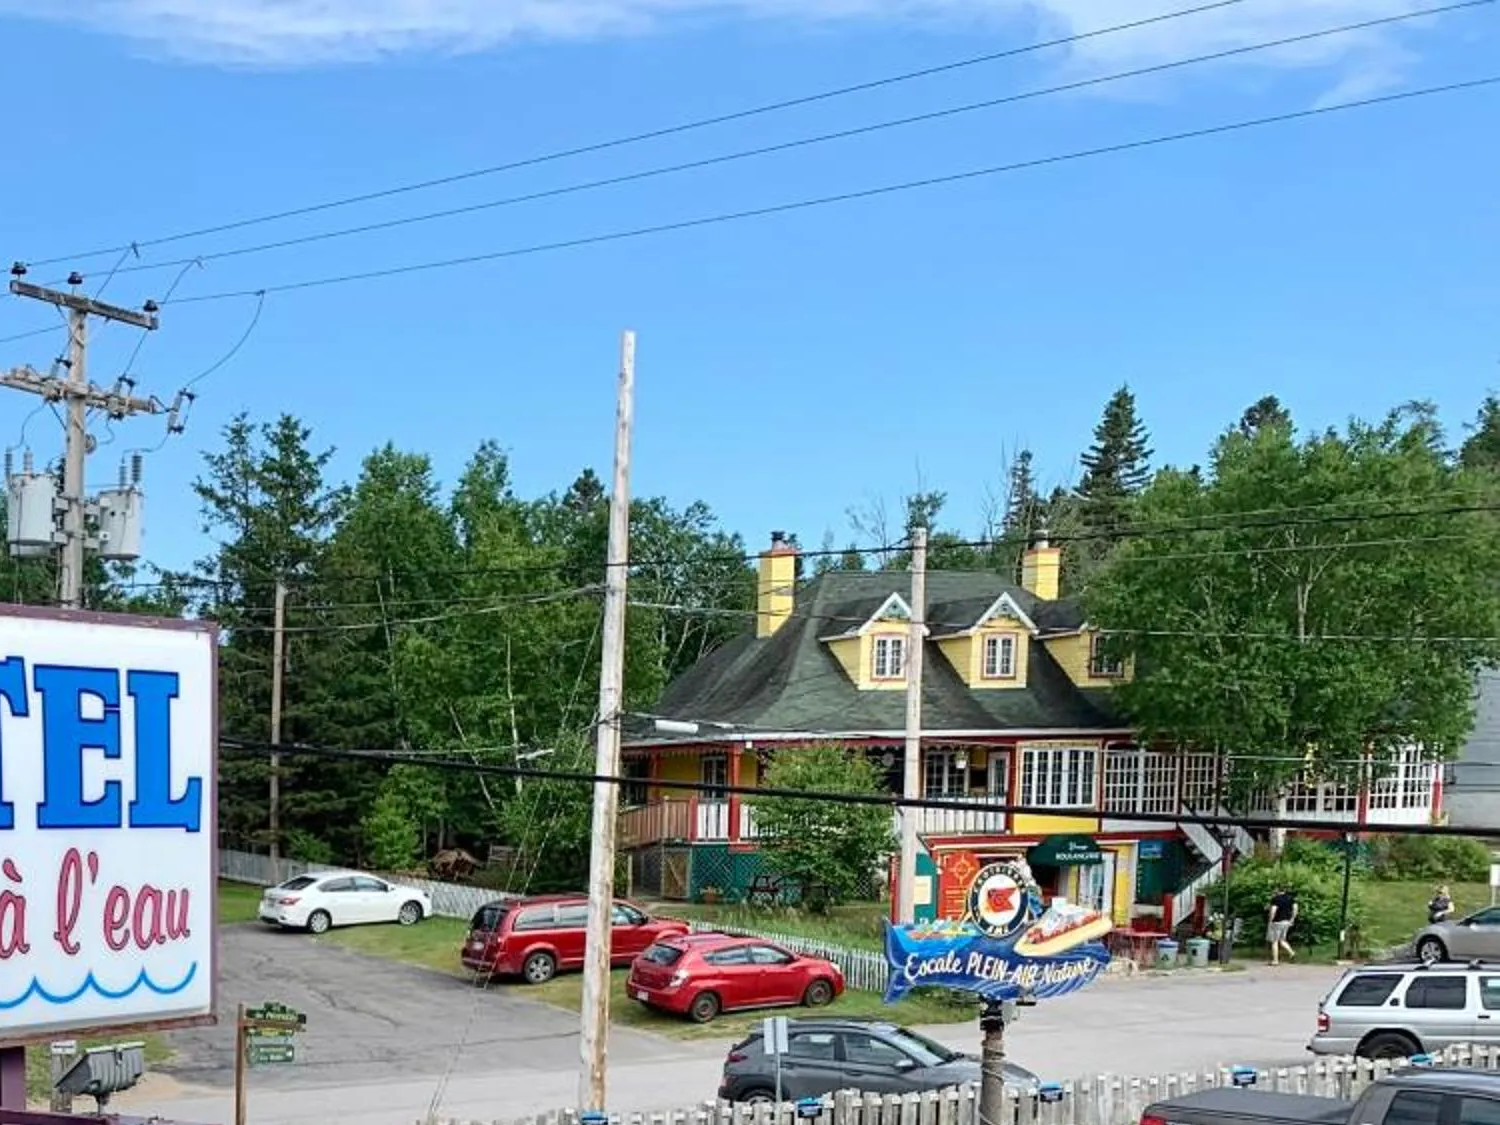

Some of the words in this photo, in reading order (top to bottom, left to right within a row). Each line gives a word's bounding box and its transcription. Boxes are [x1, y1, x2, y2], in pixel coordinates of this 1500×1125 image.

[53, 847, 192, 956] l'eau
[904, 952, 962, 980] Escale
[1038, 956, 1095, 985] Nature
